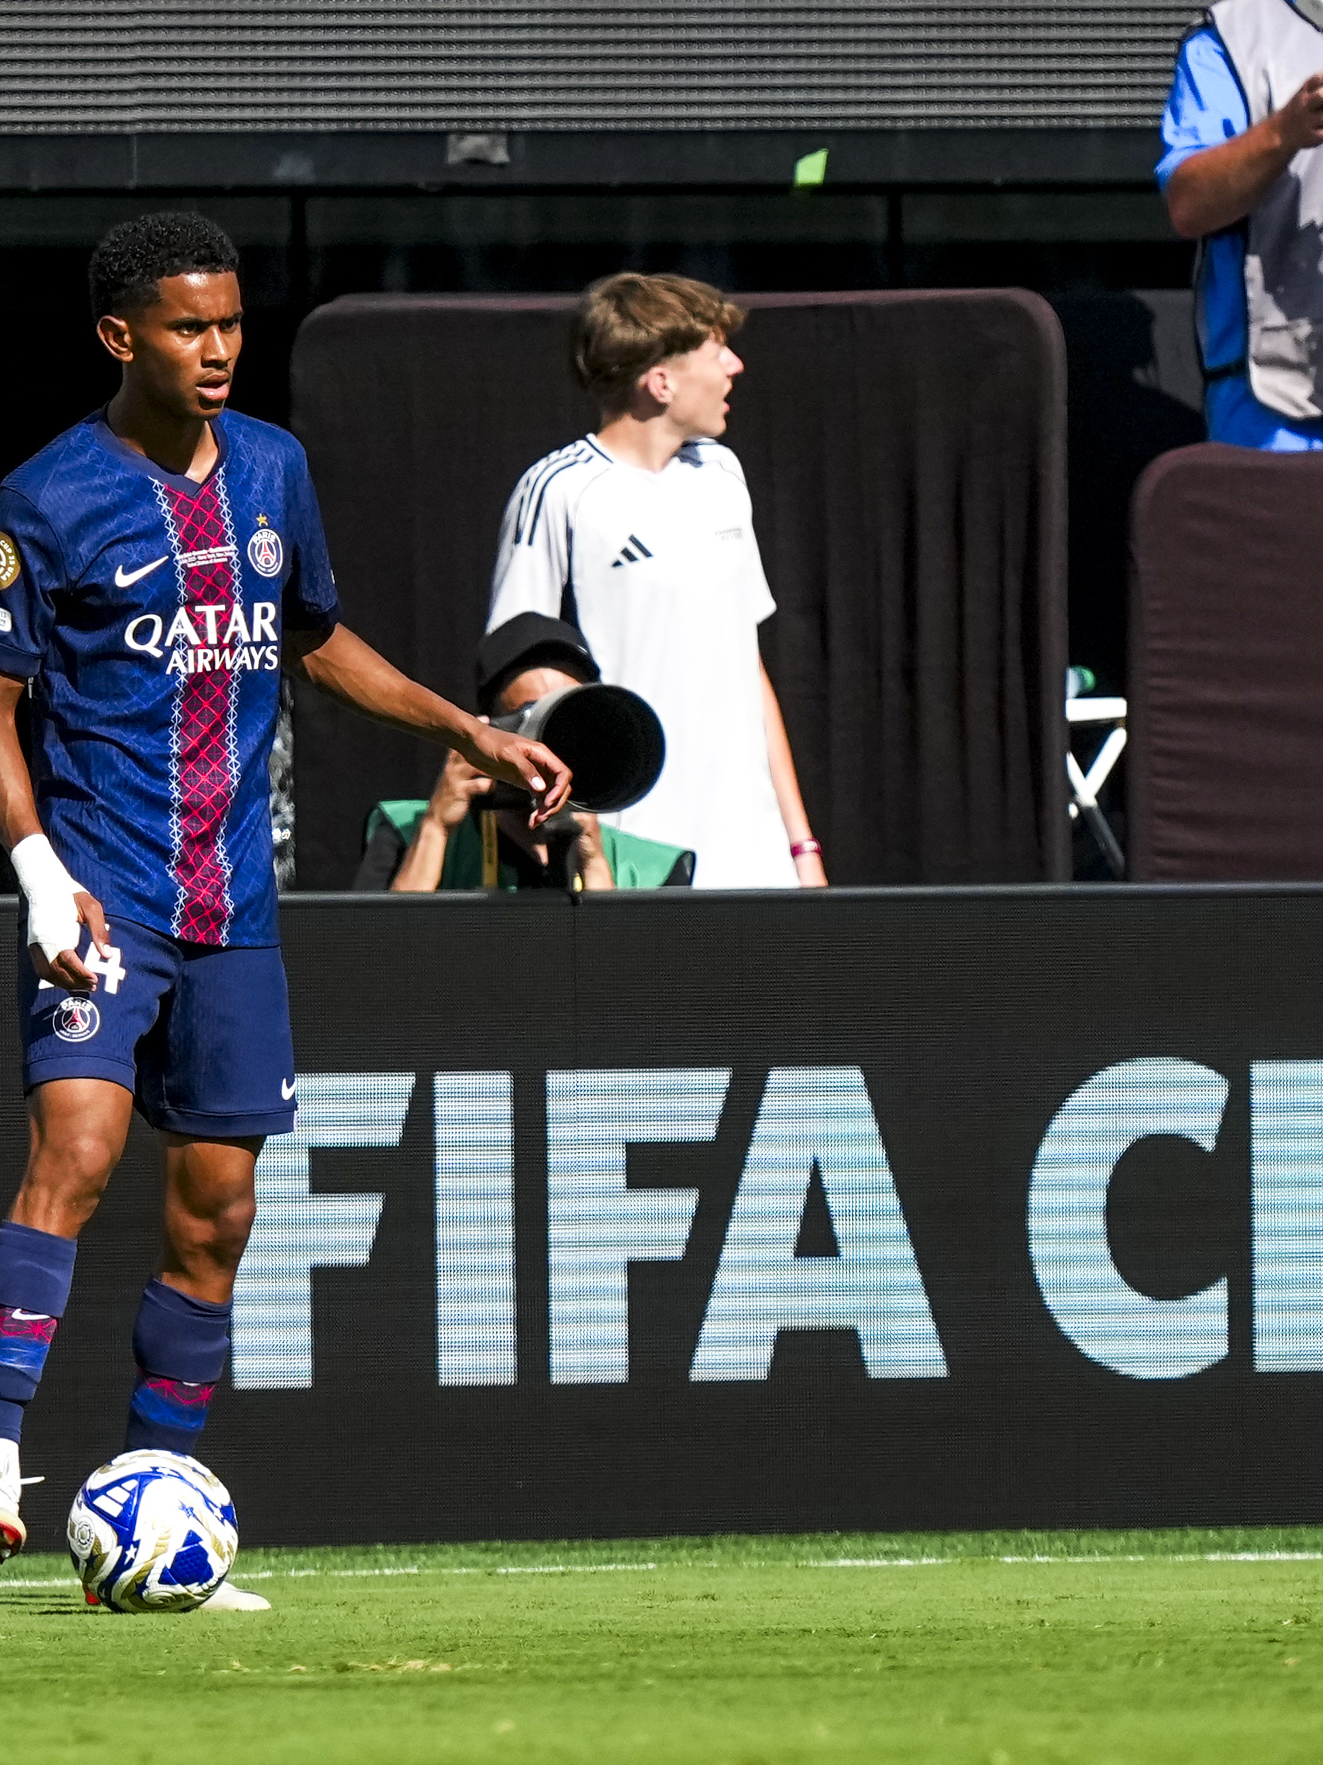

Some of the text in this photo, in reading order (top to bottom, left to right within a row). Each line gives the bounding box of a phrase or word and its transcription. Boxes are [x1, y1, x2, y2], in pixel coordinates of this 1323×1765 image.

[252, 531, 276, 544] PARIS
[0, 540, 12, 553] CUP
[0, 566, 14, 581] USA
[124, 602, 278, 658] QATAR
[166, 645, 278, 675] AIRWAYS
[61, 999, 93, 1012] PARIS
[231, 1066, 948, 1390] FIFA
